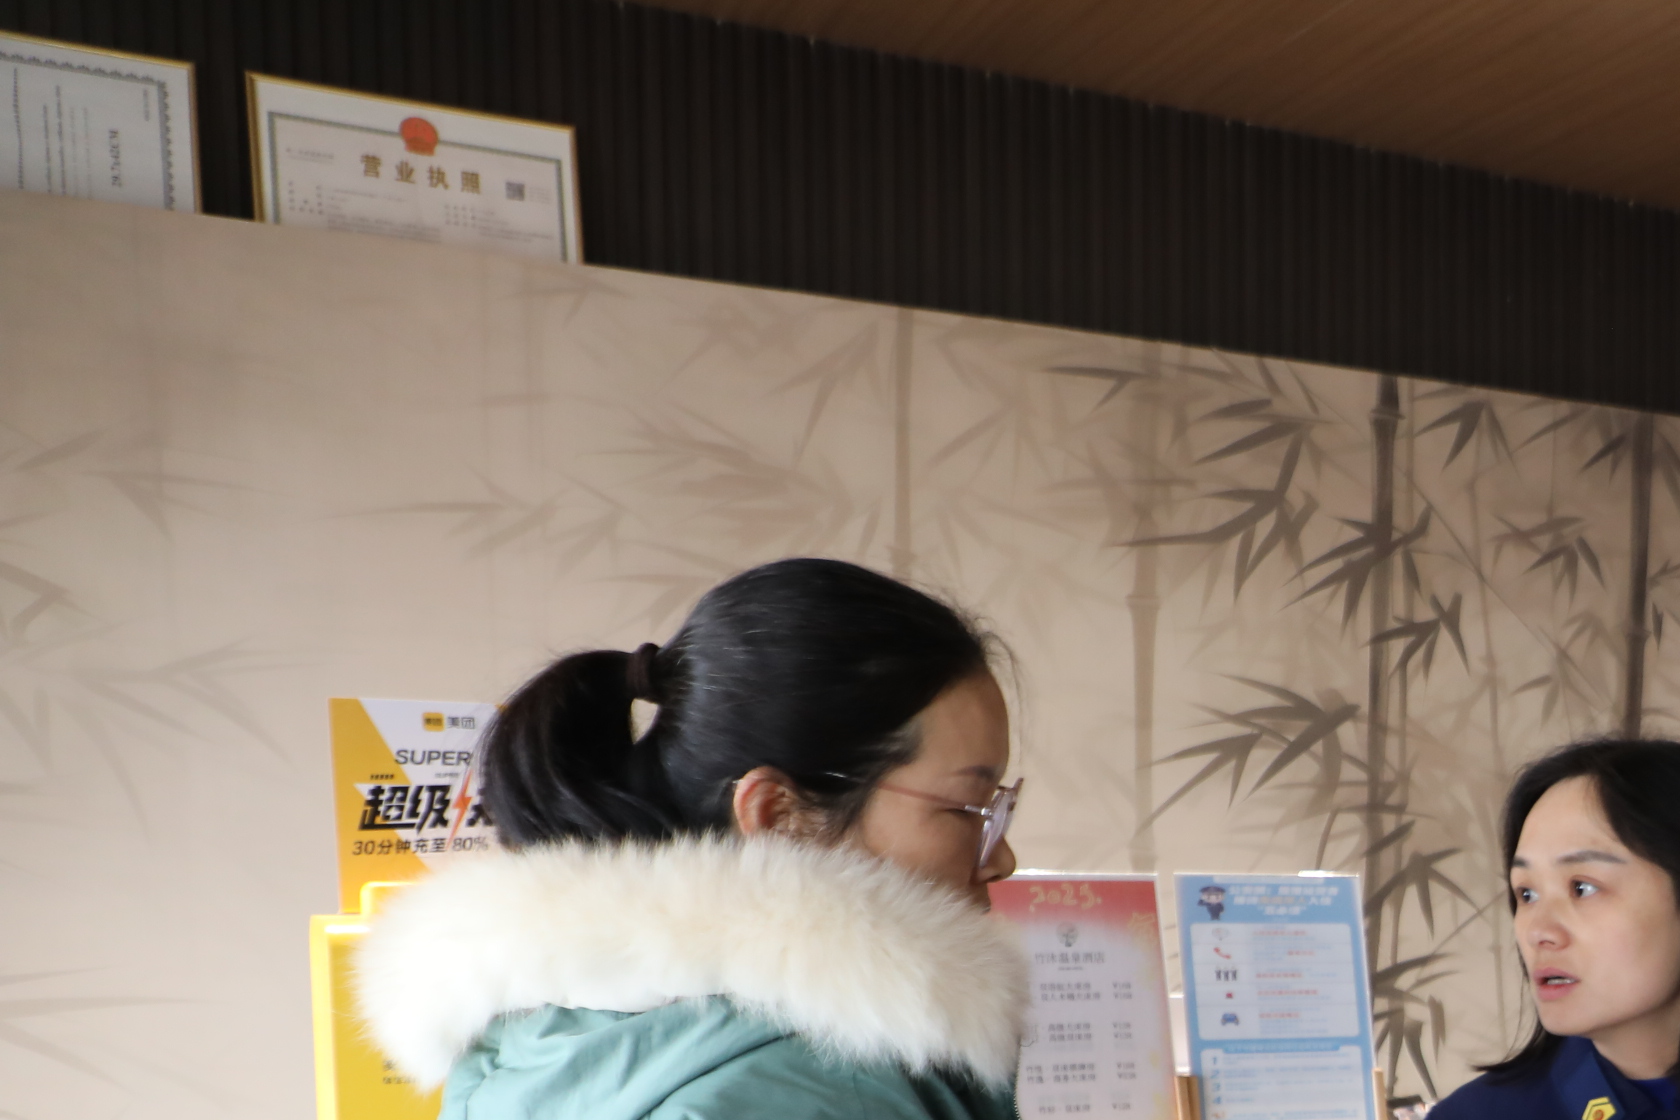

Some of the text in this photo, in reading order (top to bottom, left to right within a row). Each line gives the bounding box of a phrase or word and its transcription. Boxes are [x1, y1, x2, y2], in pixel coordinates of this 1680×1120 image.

[360, 154, 482, 195] 营业执照
[395, 749, 473, 766] SUPER
